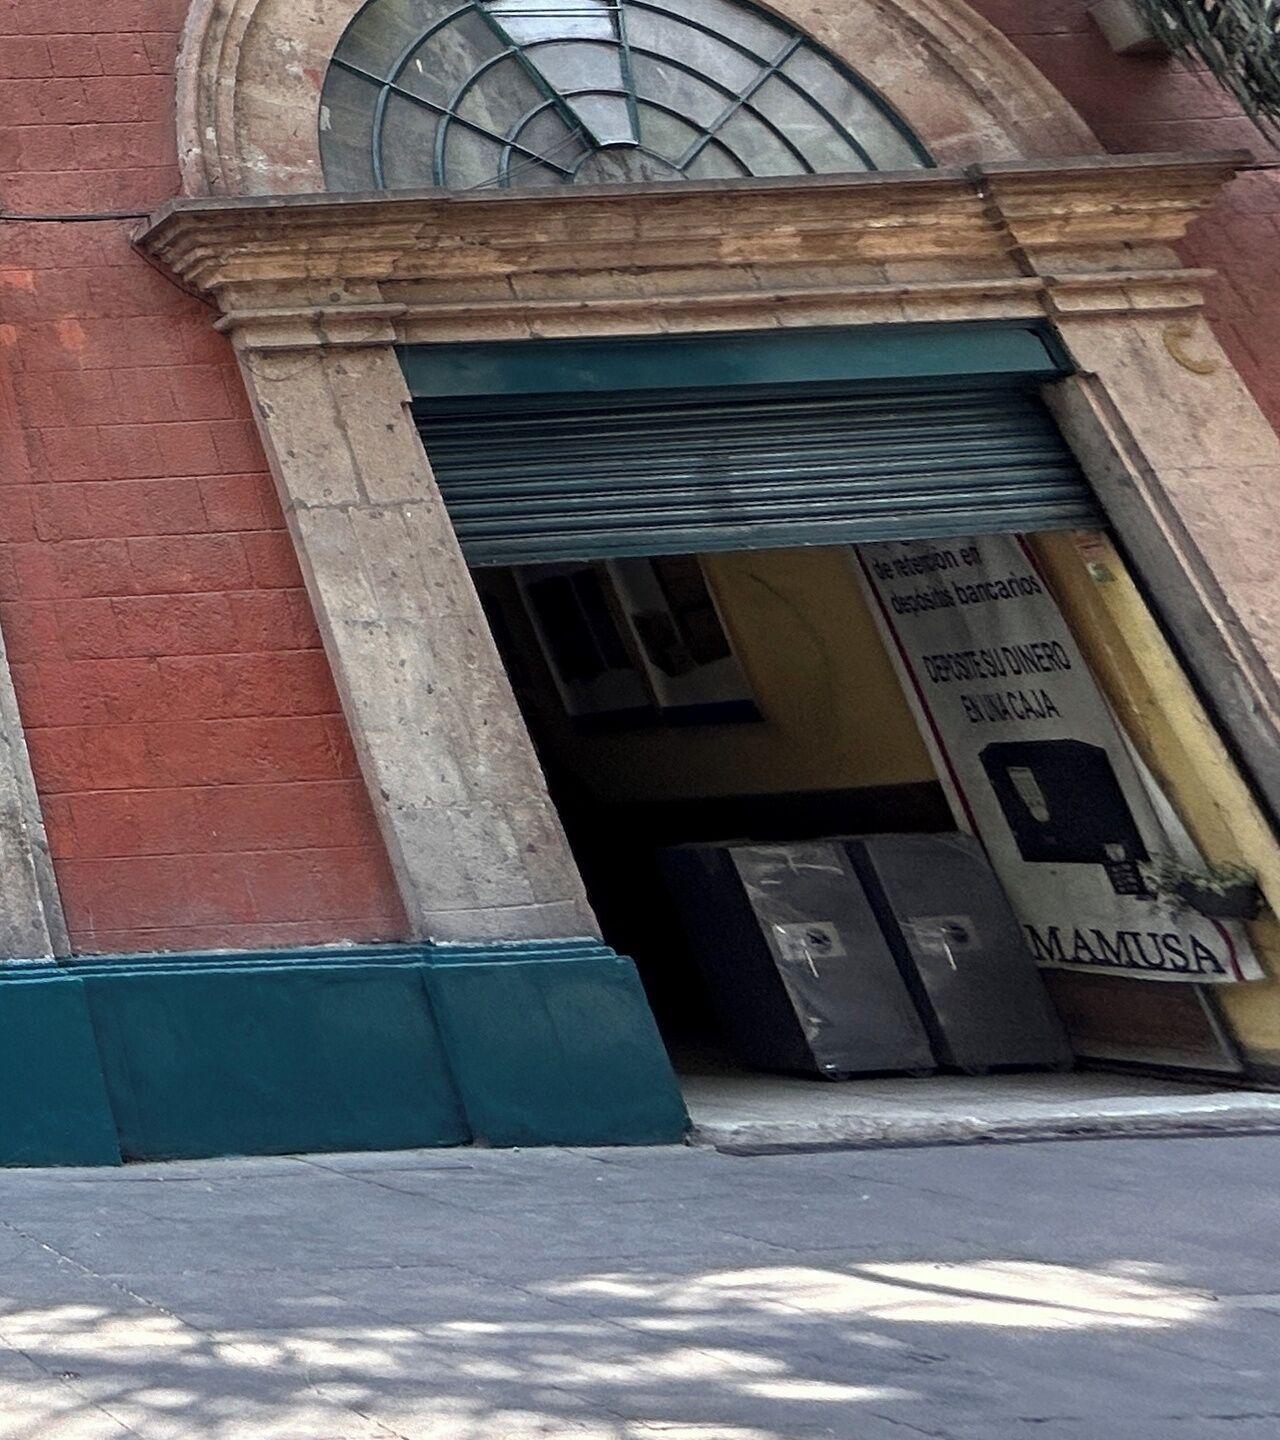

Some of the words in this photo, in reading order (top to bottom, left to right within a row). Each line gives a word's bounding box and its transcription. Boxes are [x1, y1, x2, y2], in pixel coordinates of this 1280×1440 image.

[953, 571, 1043, 605] bancarios
[980, 647, 1007, 678] SU
[1001, 640, 1072, 675] DINERO
[1007, 688, 1062, 720] CAJA
[1023, 924, 1227, 974] MAMUSA
